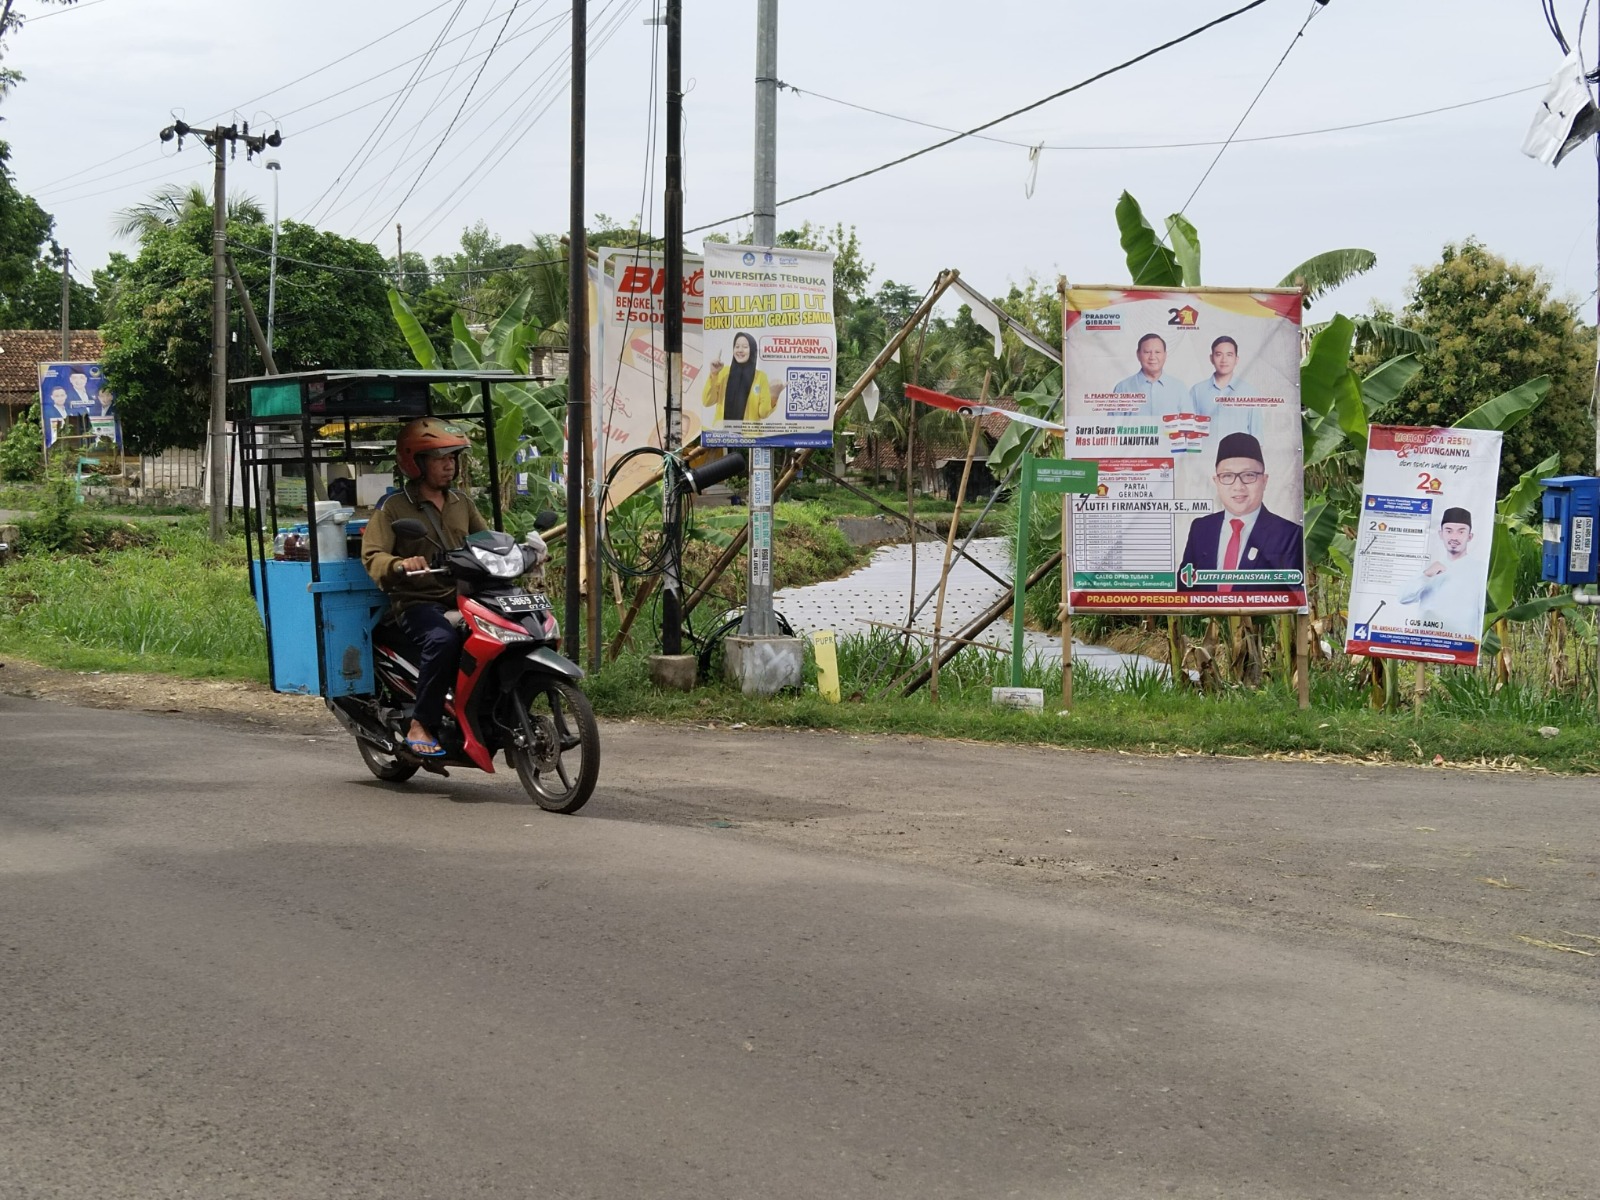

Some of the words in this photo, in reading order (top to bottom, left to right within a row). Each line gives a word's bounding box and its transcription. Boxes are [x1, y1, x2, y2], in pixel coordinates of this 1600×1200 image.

[710, 270, 778, 281] UNIVERSITAS
[780, 274, 826, 286] TERBUKA
[710, 294, 776, 314] KULIAH
[780, 292, 800, 310] DI
[804, 294, 826, 310] UT
[704, 314, 731, 330] BUKU
[733, 314, 766, 329] KULIAH
[767, 312, 800, 328] GRATIS
[802, 310, 834, 325] SEMUA
[772, 338, 820, 346] TERJAMIN
[764, 346, 828, 354] KUALITASNYA
[1076, 426, 1094, 435] Surat
[1096, 426, 1115, 434] Suara
[1116, 426, 1138, 434] Warna
[1140, 426, 1158, 434] HIJAU
[1076, 437, 1090, 446] Mas
[1092, 437, 1108, 446] Lutfi
[1120, 436, 1160, 446] LANJUTKAN
[1446, 436, 1472, 446] RESTU
[1396, 443, 1412, 458] &
[1413, 445, 1470, 458] DUKUNGANNYA
[754, 472, 761, 482] WC
[1085, 502, 1108, 510] LUTFI
[1112, 502, 1172, 512] FIRMANSYAH,
[1192, 503, 1210, 511] MM.
[1369, 520, 1378, 531] 2
[1576, 519, 1582, 530] WC
[1086, 596, 1138, 604] PRABOWO
[1140, 596, 1188, 604] PRESIDEN
[1190, 596, 1244, 604] INDONESIA
[1246, 595, 1289, 603] MENANG
[1423, 620, 1439, 629] AANG
[1355, 626, 1368, 640] 4
[815, 636, 834, 646] PUPR
